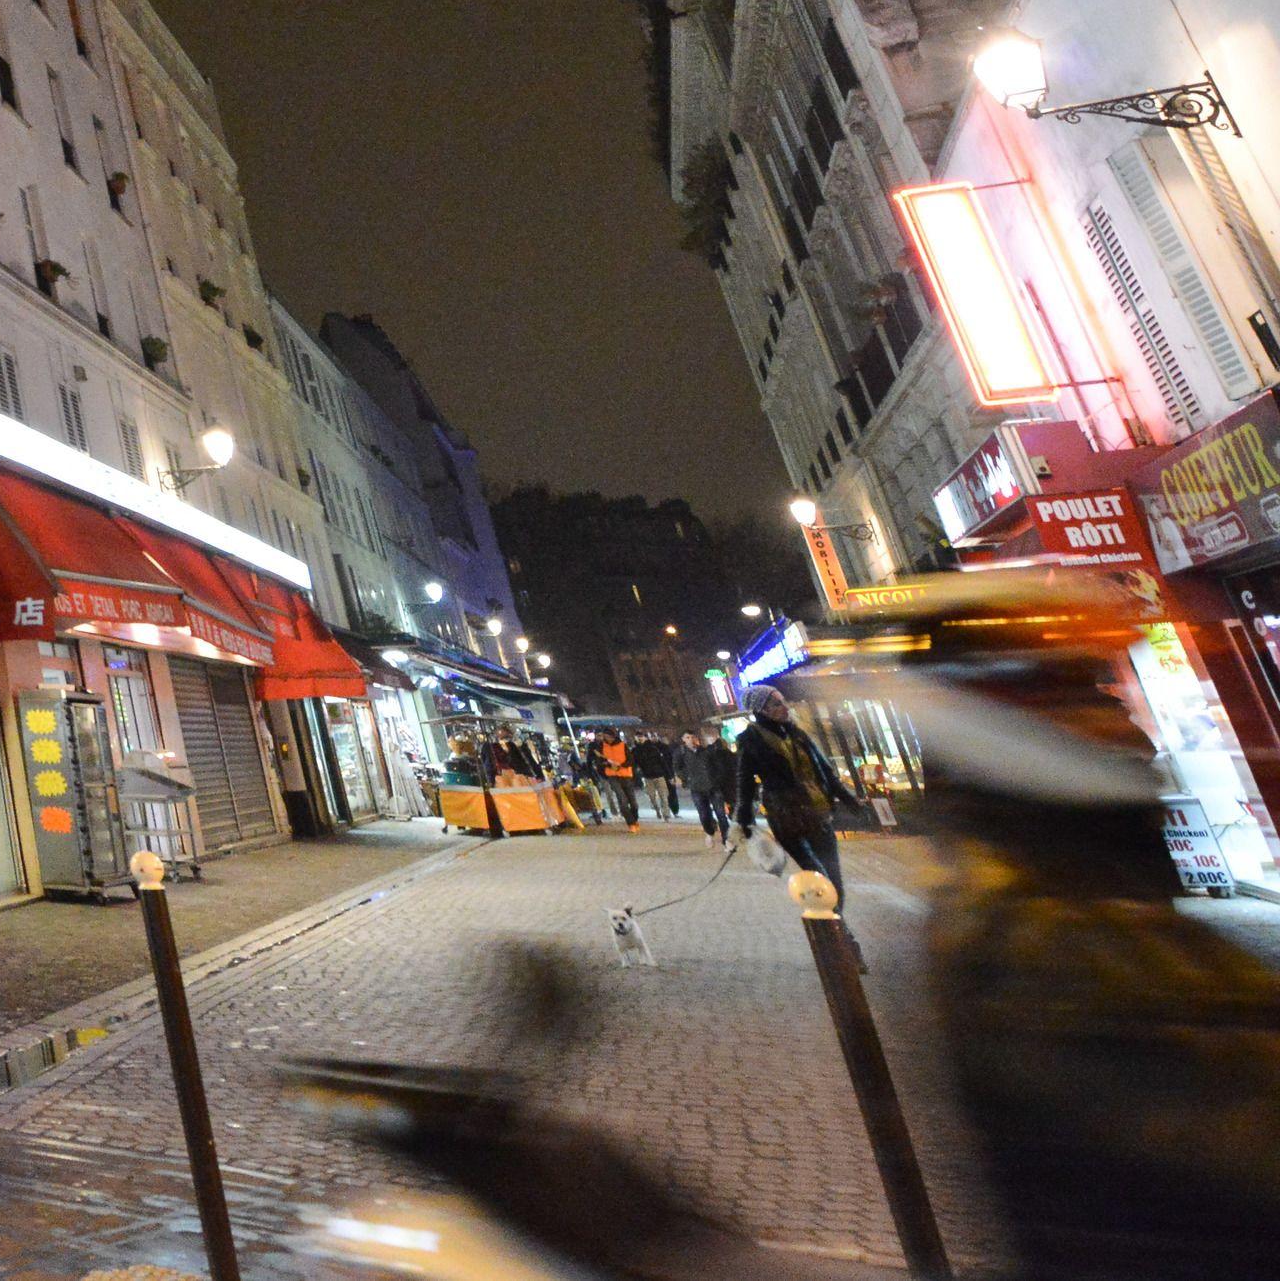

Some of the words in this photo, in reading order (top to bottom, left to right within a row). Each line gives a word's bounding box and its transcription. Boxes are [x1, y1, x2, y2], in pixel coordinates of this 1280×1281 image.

[1161, 422, 1280, 527] COIFFEUR
[1036, 495, 1125, 523] POULET
[1064, 521, 1127, 548] RÔTI
